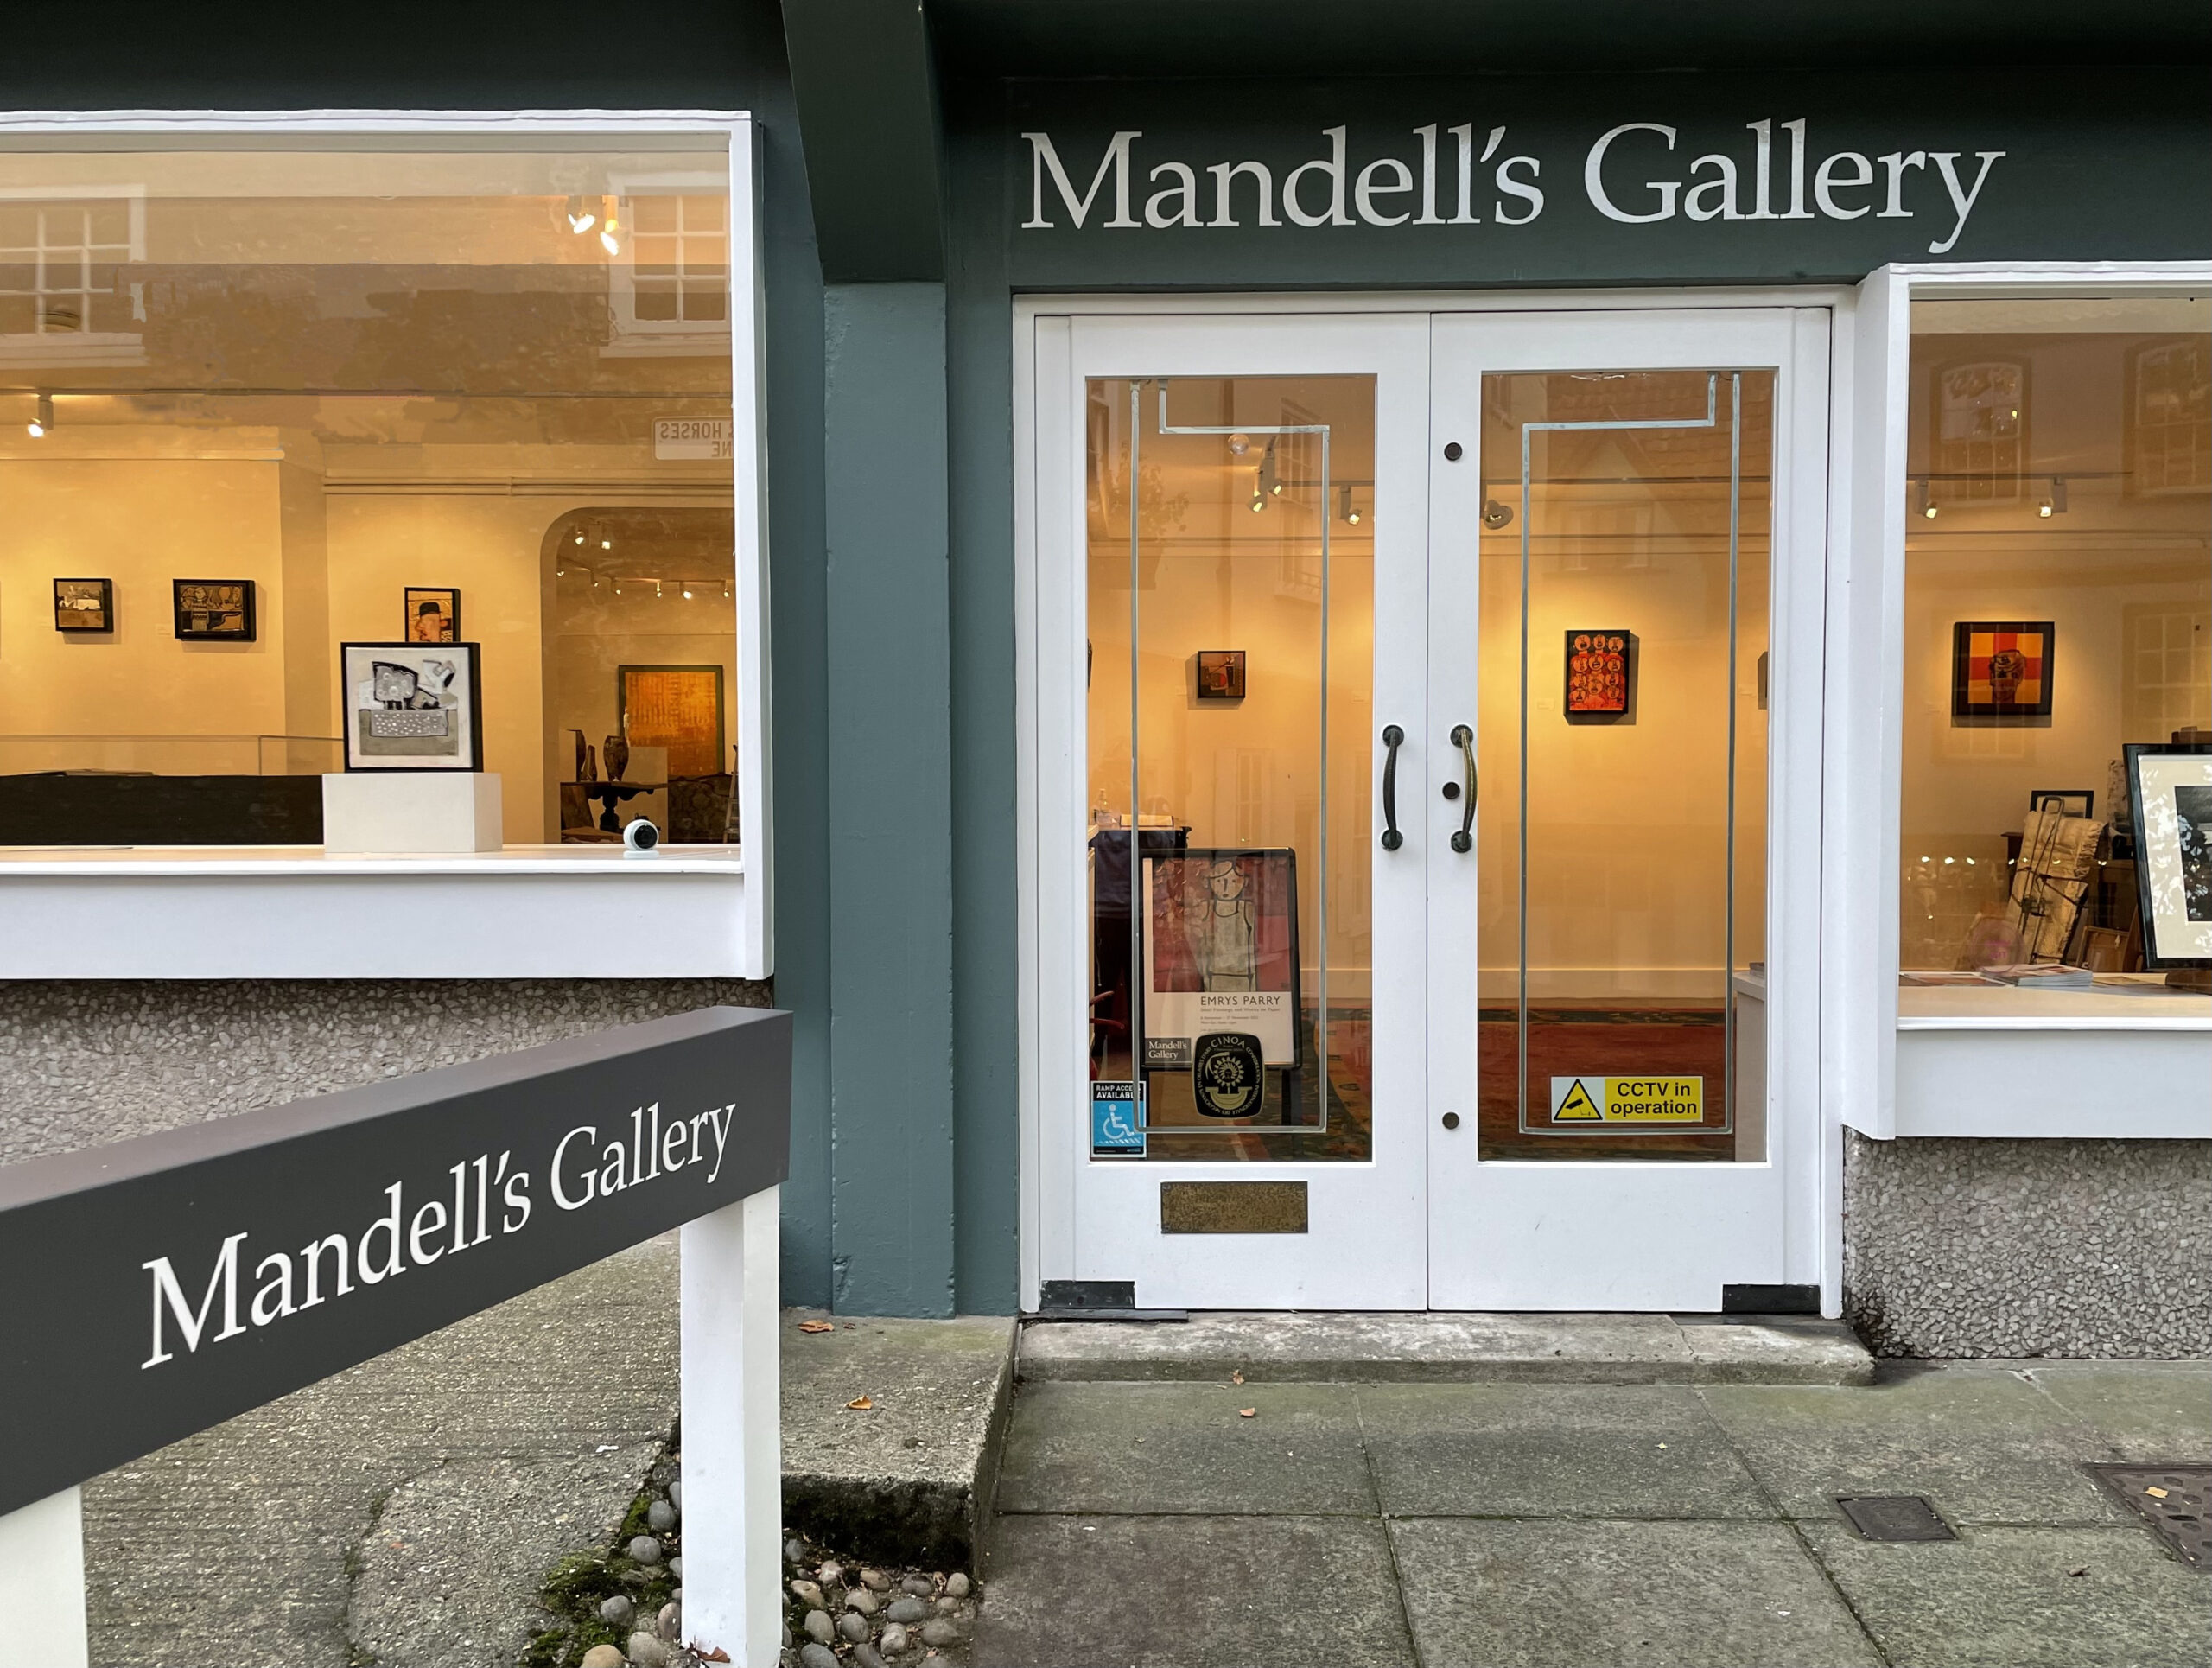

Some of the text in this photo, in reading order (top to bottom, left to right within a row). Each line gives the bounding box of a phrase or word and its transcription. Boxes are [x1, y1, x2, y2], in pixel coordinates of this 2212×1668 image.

[1021, 118, 2007, 254] Mandell's Gallery
[1200, 996, 1281, 1006] EMRYS PARRY
[1148, 1041, 1187, 1050] Mandell's
[1211, 1036, 1245, 1048] CINOA
[1148, 1049, 1179, 1061] Gallery
[1618, 1082, 1691, 1097] CCTV in
[1611, 1100, 1697, 1118] operation
[141, 1101, 736, 1370] Mandell's Gallery
